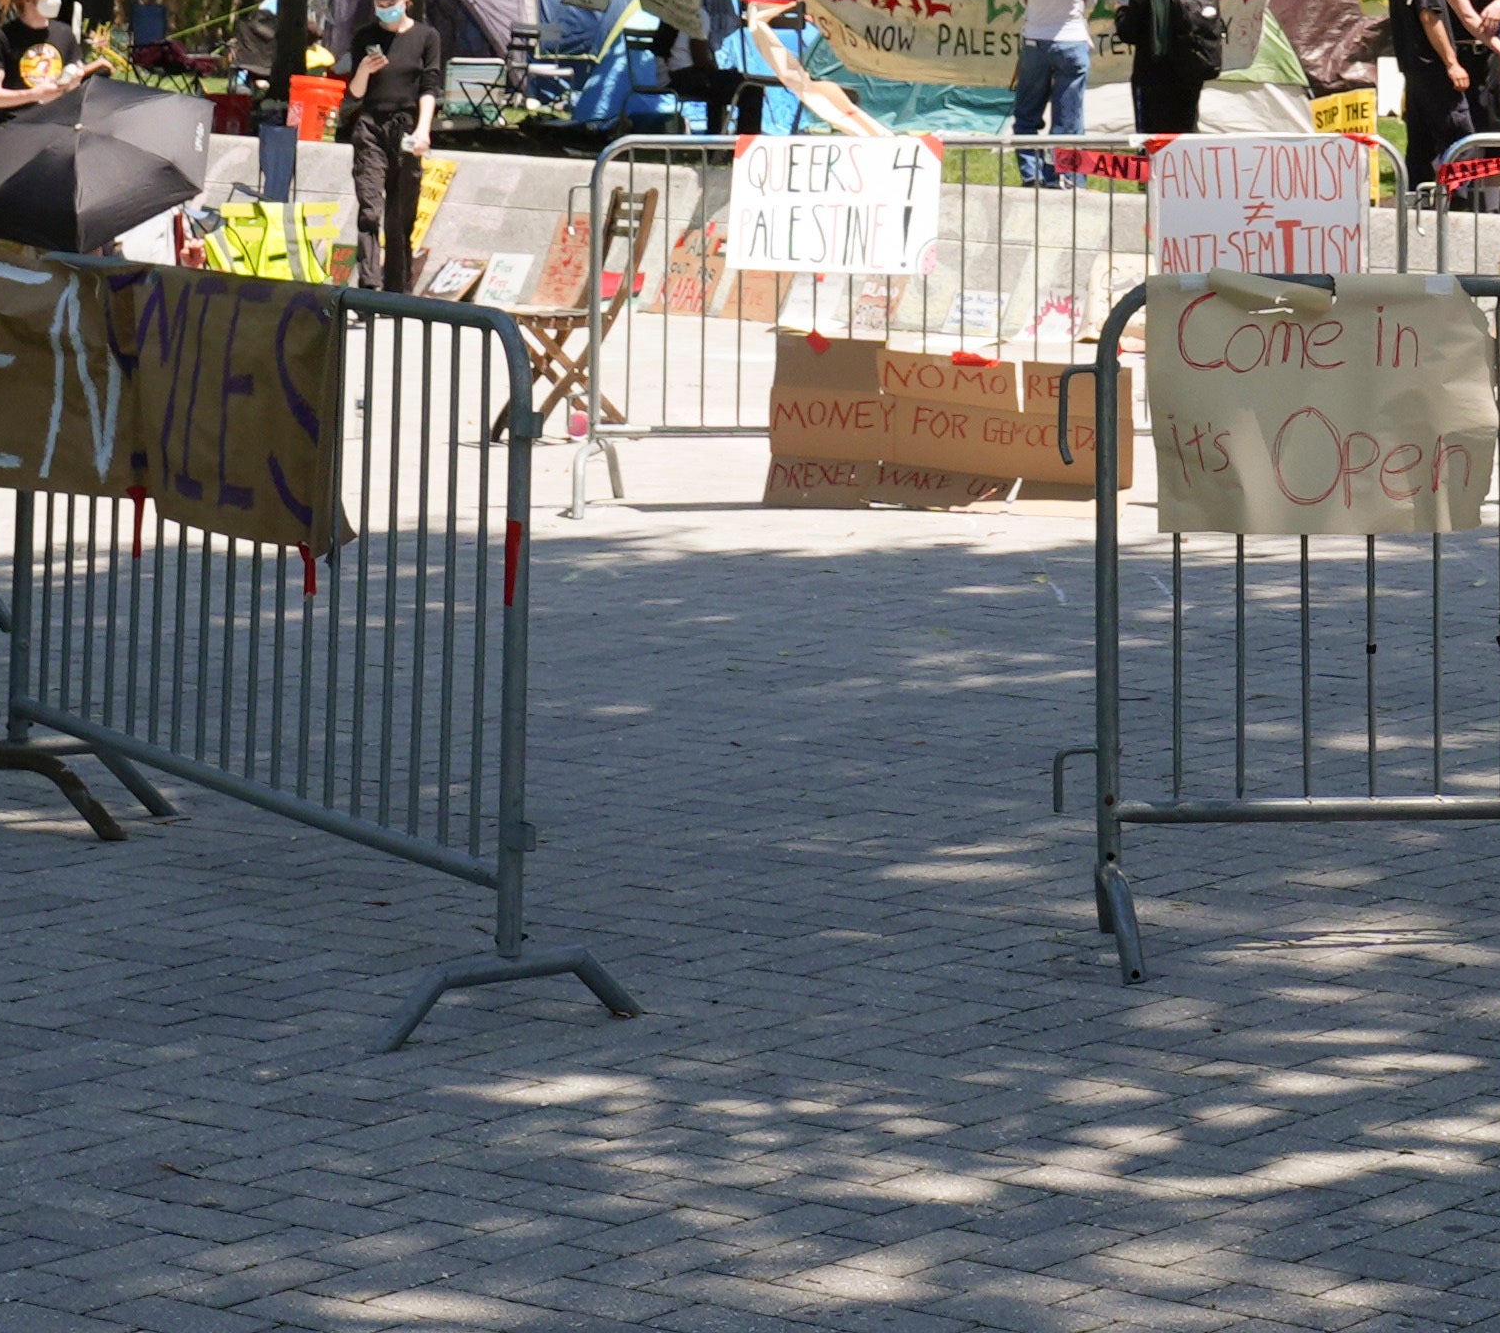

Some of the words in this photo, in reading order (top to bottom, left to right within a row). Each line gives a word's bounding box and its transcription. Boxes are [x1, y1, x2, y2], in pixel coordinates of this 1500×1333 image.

[865, 24, 916, 53] NOW
[1345, 102, 1369, 121] THE
[747, 143, 864, 196] QUEERS
[892, 144, 924, 201] 4
[1160, 139, 1361, 202] ANTI-ZIONISM
[1178, 291, 1346, 373] Come
[1376, 305, 1419, 368] in
[773, 400, 897, 433] MONEY
[912, 407, 968, 439] FOR
[769, 461, 860, 489] DREXEL
[879, 463, 949, 489] WAKE
[1272, 406, 1472, 509] Open
